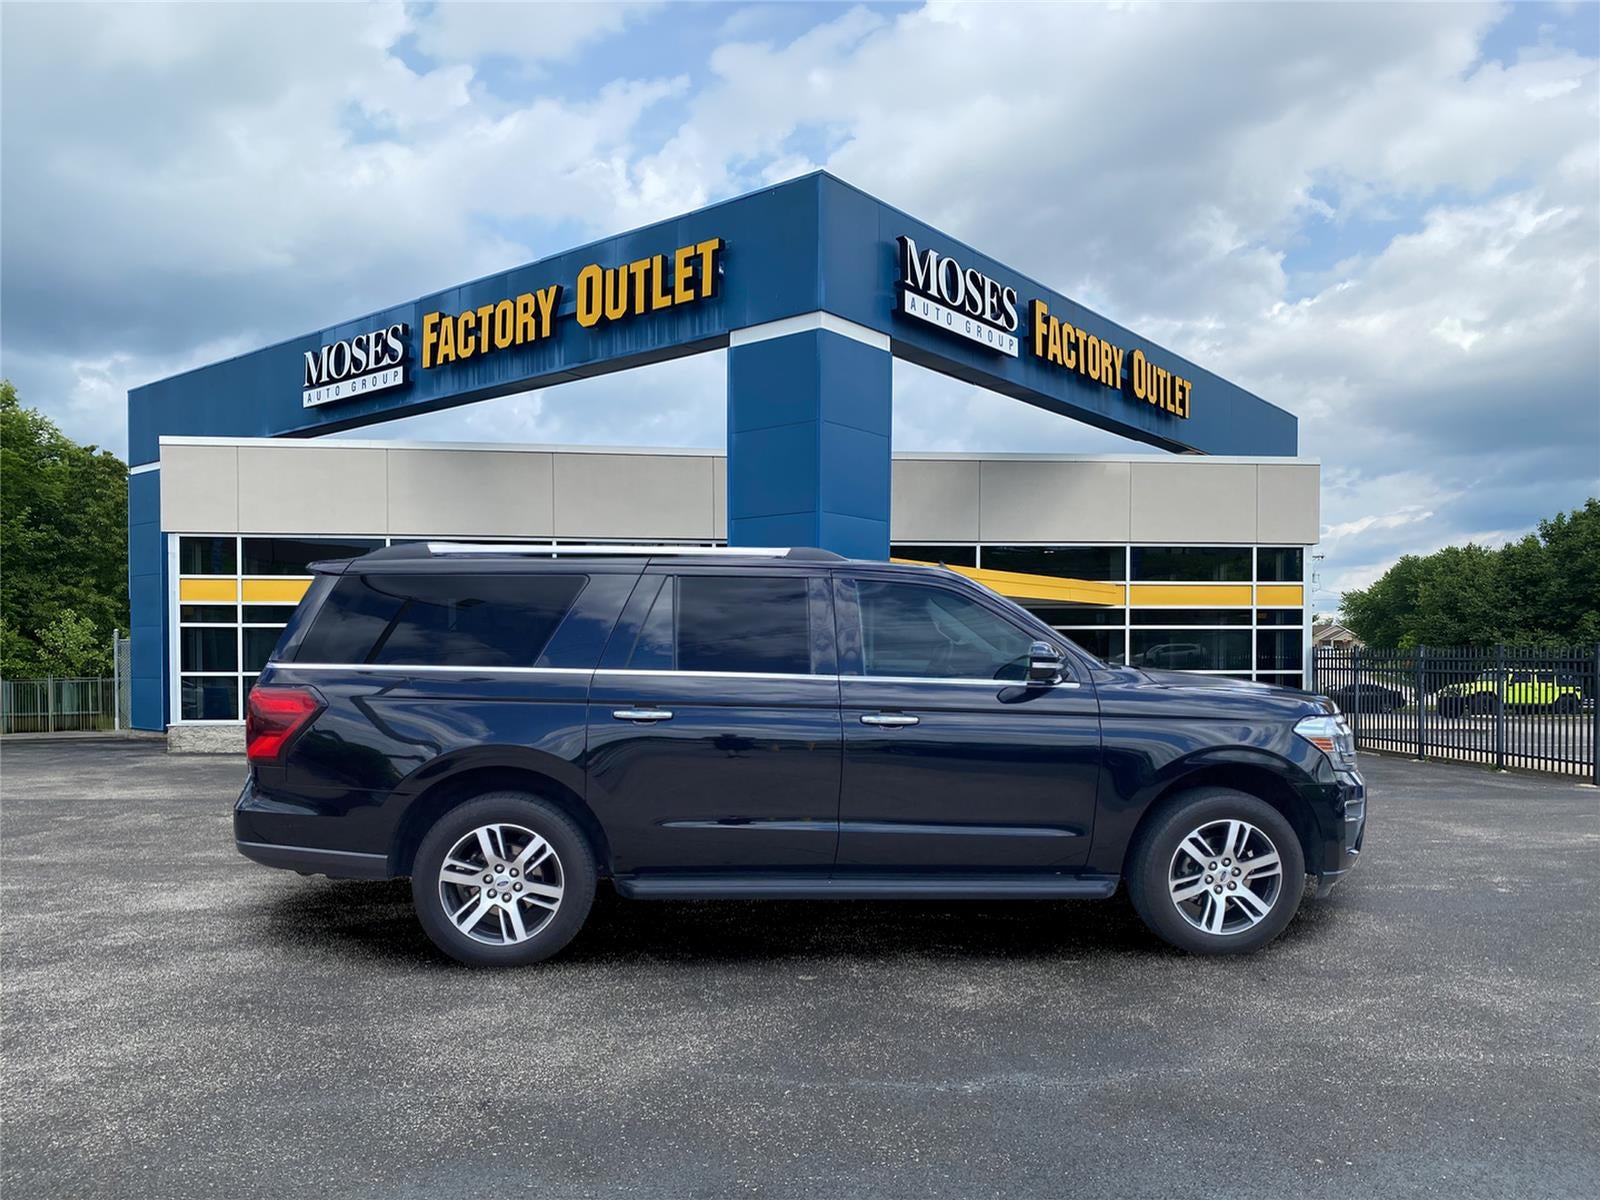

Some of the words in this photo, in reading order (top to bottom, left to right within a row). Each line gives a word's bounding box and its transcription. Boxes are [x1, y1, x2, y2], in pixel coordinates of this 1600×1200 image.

[422, 284, 559, 369] FACTORY
[576, 237, 720, 328] OUTLET
[903, 235, 1018, 332] MOSES
[910, 297, 953, 326] AUTO
[965, 319, 1015, 351] GROUP
[303, 323, 404, 388] MOSES
[307, 385, 341, 405] AUTO
[351, 369, 400, 393] GROUP
[1034, 299, 1124, 390] FACTORY
[1132, 348, 1192, 419] OUTLET
